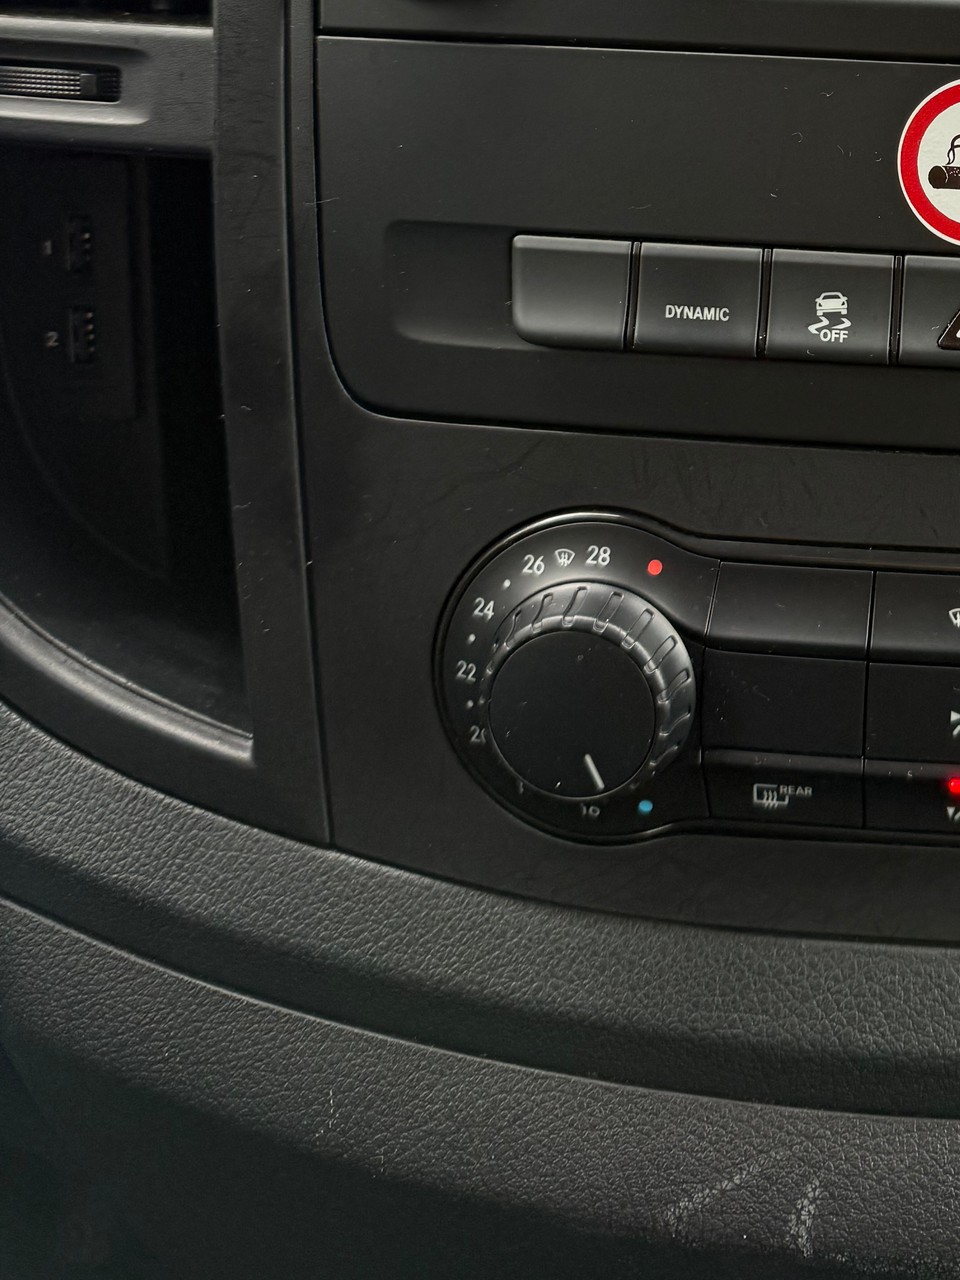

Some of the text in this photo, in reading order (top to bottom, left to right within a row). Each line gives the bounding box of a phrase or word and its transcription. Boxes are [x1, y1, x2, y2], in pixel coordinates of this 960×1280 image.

[665, 304, 730, 321] DYNAMIC
[819, 329, 849, 343] OFF
[521, 554, 546, 575] 26
[586, 545, 612, 567] 28
[473, 597, 495, 620] 24
[456, 660, 477, 684] 22
[780, 784, 813, 797] REAR
